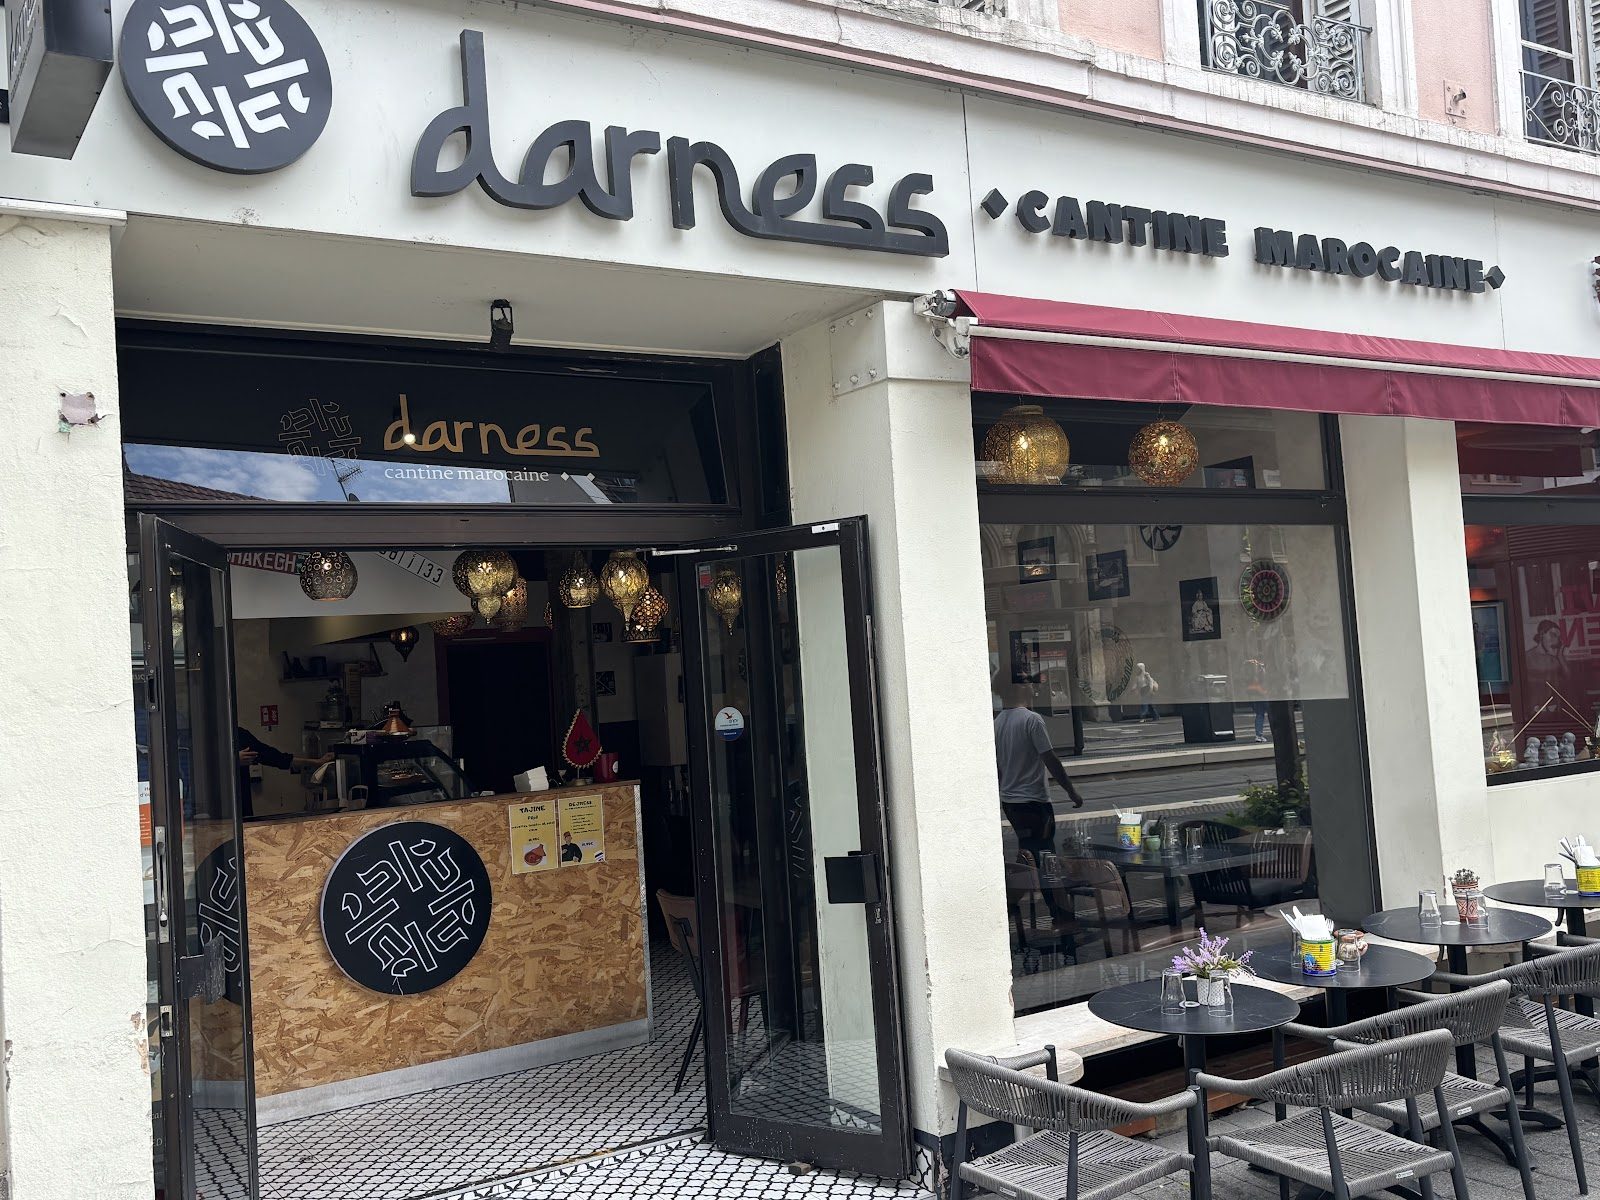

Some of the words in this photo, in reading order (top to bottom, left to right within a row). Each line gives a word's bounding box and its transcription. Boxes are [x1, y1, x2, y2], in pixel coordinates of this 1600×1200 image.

[410, 29, 949, 258] darness
[1016, 189, 1229, 258] CANTINE
[1253, 227, 1486, 293] MAROCAINE
[383, 393, 600, 457] darness
[384, 464, 453, 481] cantine
[458, 467, 549, 482] marocaine
[519, 805, 546, 813] TAJINE
